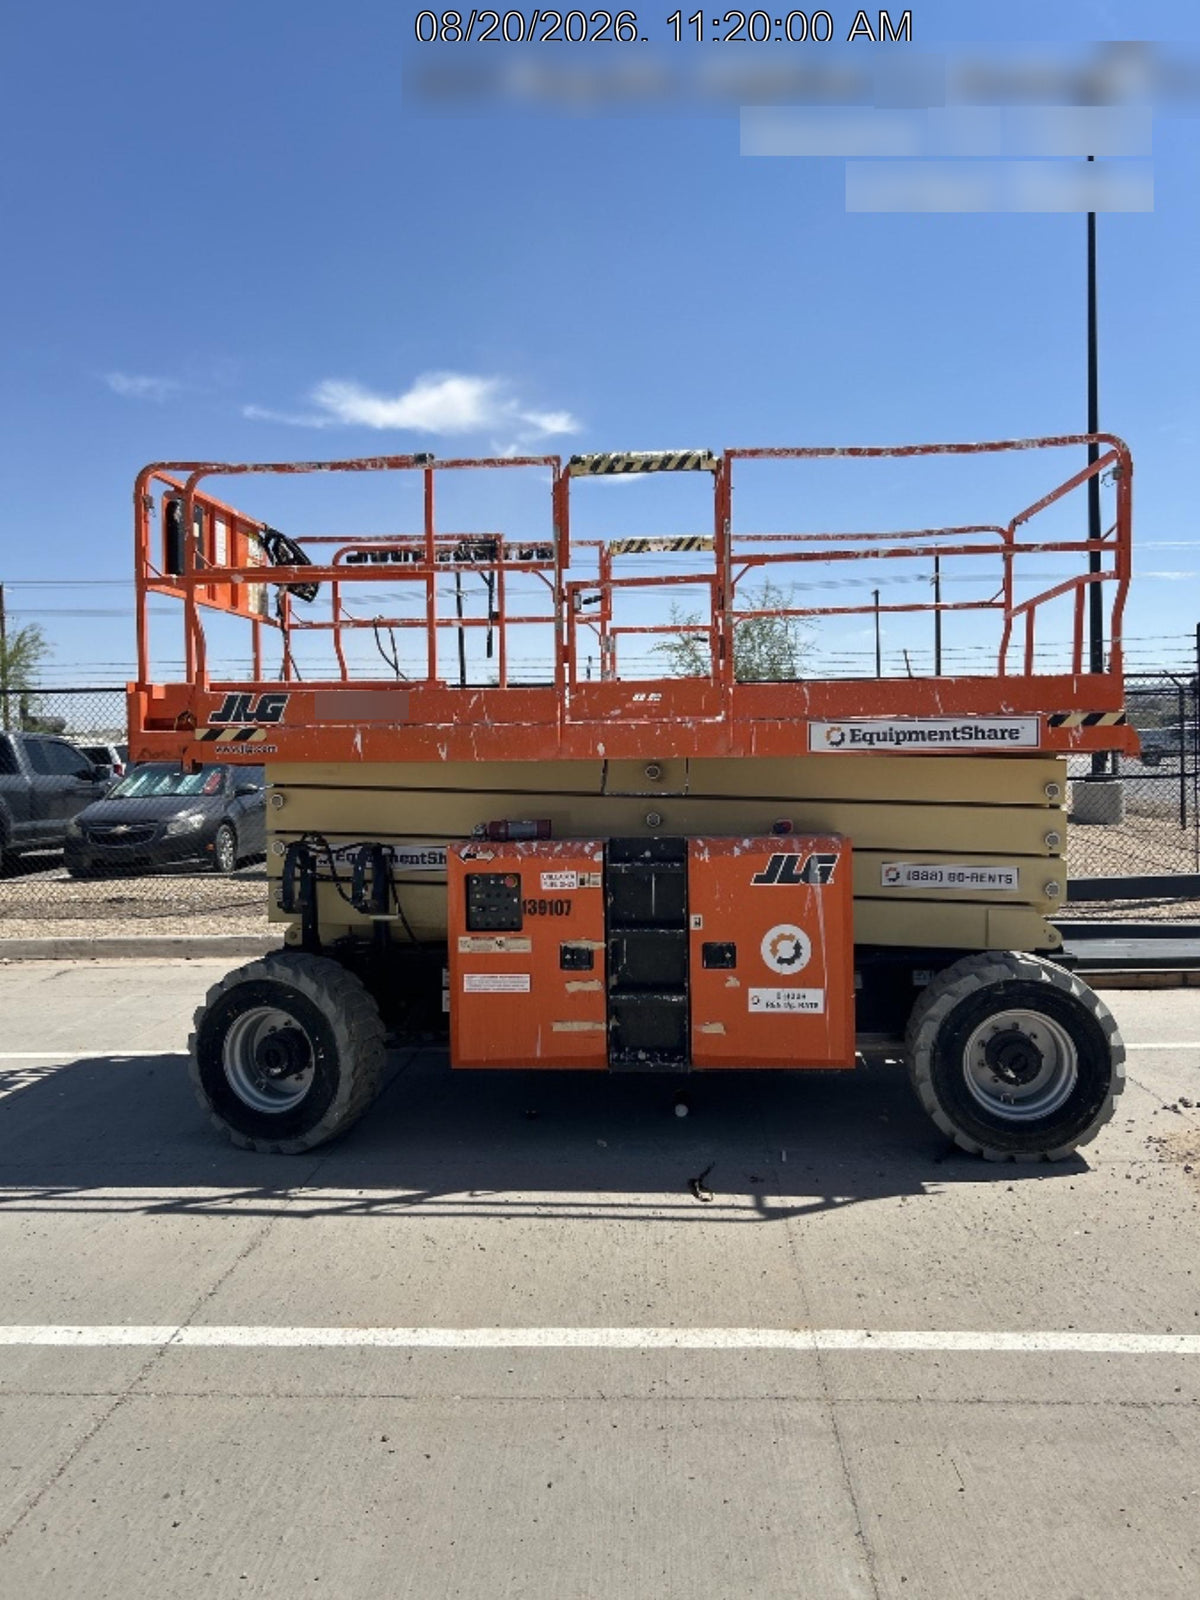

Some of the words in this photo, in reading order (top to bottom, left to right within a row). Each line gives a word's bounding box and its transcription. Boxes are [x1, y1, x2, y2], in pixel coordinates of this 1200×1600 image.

[208, 692, 291, 724] JLG
[849, 725, 1021, 746] EquipmentShare
[750, 853, 840, 886] JLG
[521, 898, 572, 916] 139107
